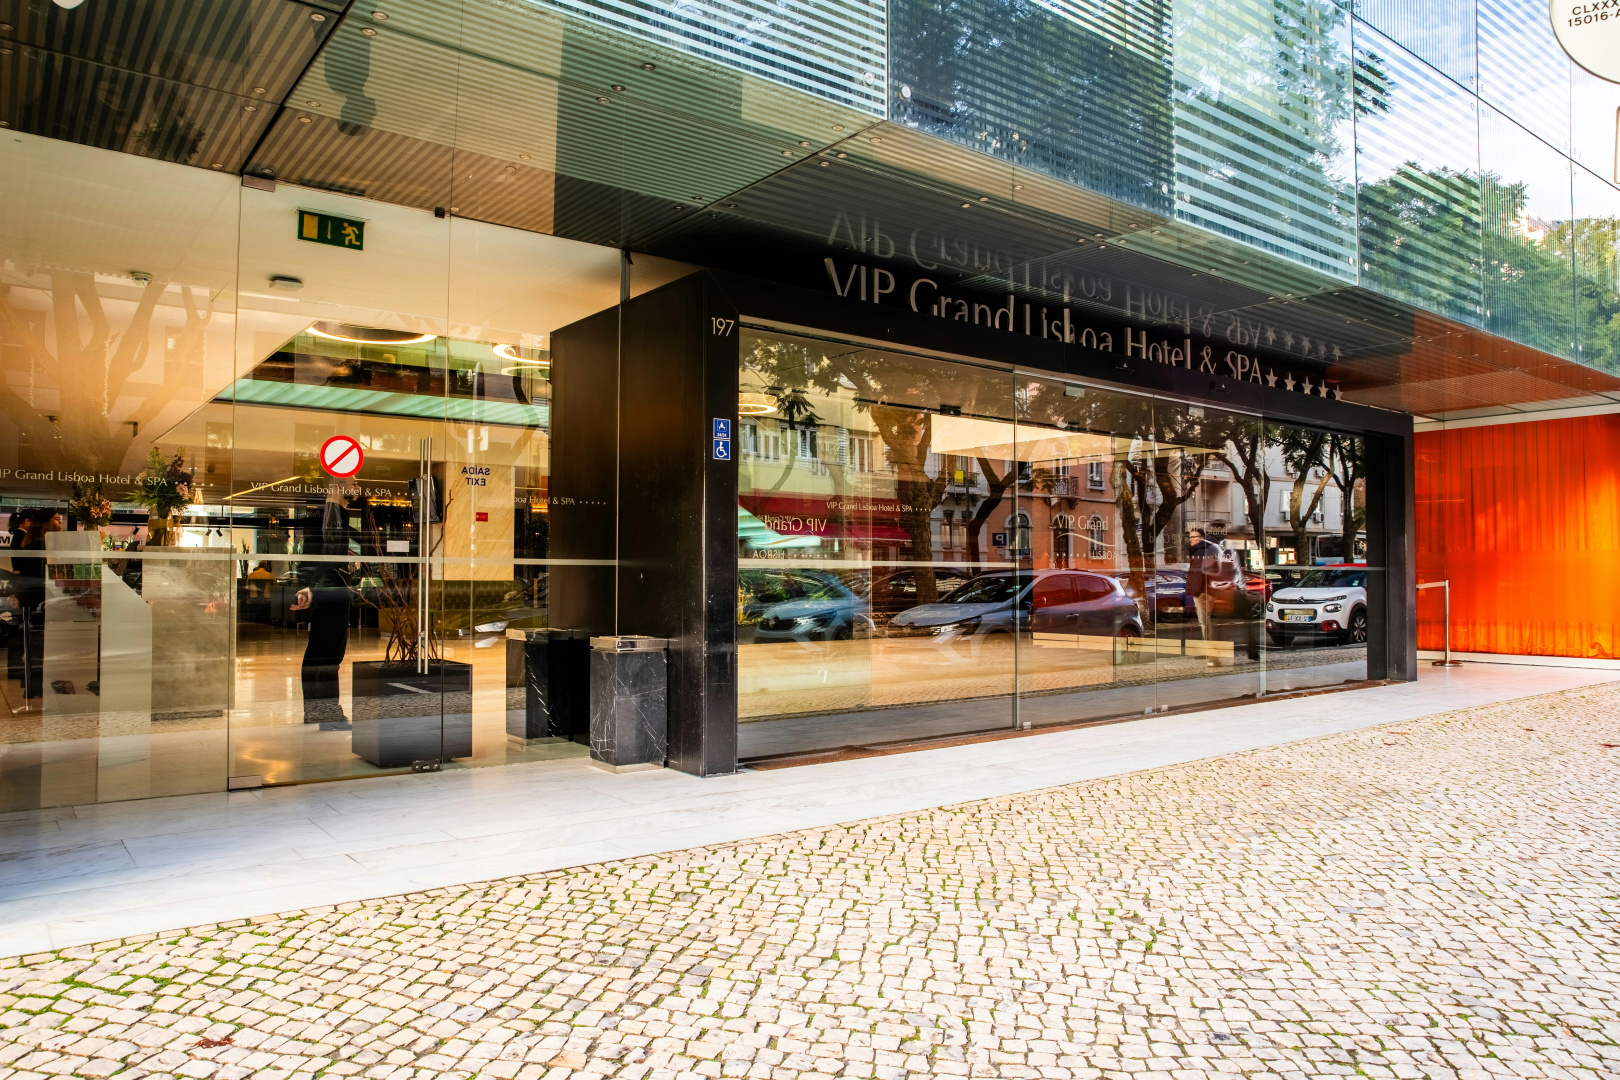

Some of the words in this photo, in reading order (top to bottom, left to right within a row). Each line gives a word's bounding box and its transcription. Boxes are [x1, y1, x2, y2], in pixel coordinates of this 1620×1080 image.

[711, 316, 735, 337] 197
[824, 257, 896, 304] VIP
[909, 278, 1015, 332] Grand
[1124, 326, 1191, 370] Hotel
[1200, 345, 1217, 375] &
[1226, 350, 1263, 385] SPA
[14, 469, 54, 481] Grand
[58, 471, 95, 483] Lisboa
[99, 473, 131, 485] Hotel
[134, 476, 143, 486] &
[147, 476, 168, 487] SPA
[250, 481, 269, 491] VIP
[270, 482, 301, 493] Grand
[304, 484, 334, 495] Lisboa
[337, 486, 362, 496] Hotel
[364, 487, 372, 496] &
[375, 488, 392, 497] SPA
[529, 495, 550, 505] Hotel
[552, 497, 559, 505] &
[560, 498, 576, 506] SPA
[826, 501, 837, 509] VIP
[838, 502, 858, 510] Grand
[858, 502, 877, 511] Lisboa
[878, 503, 895, 512] Hotel
[901, 504, 913, 513] SPA
[1056, 514, 1075, 529] VIP
[1077, 515, 1109, 531] Grand
[1203, 522, 1228, 536] Grand
